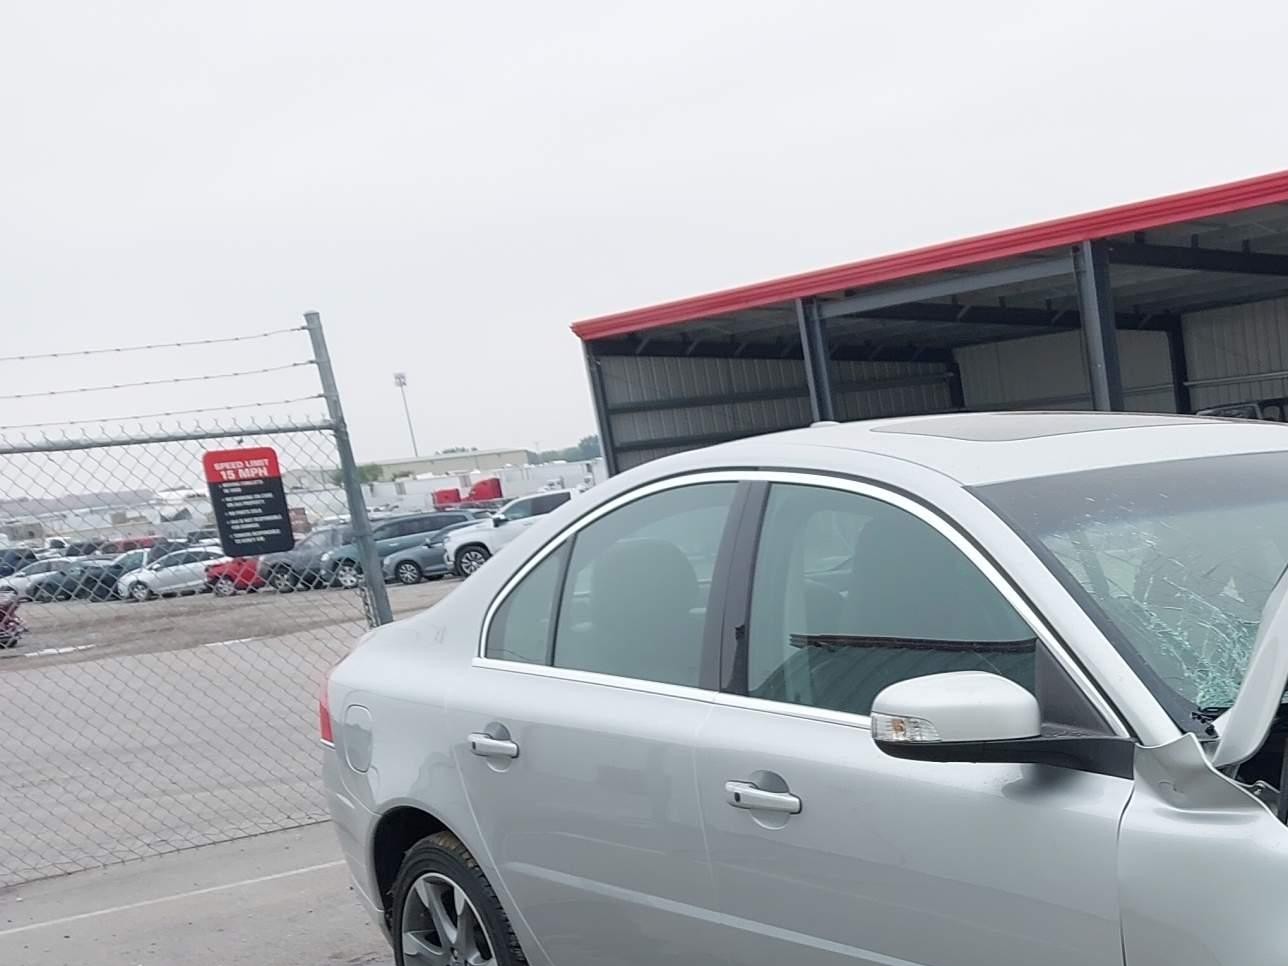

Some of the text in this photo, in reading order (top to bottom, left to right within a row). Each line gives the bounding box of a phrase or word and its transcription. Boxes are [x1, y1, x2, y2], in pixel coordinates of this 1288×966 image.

[213, 459, 269, 470] SPEED LIMIT
[219, 467, 269, 480] 15 MPH
